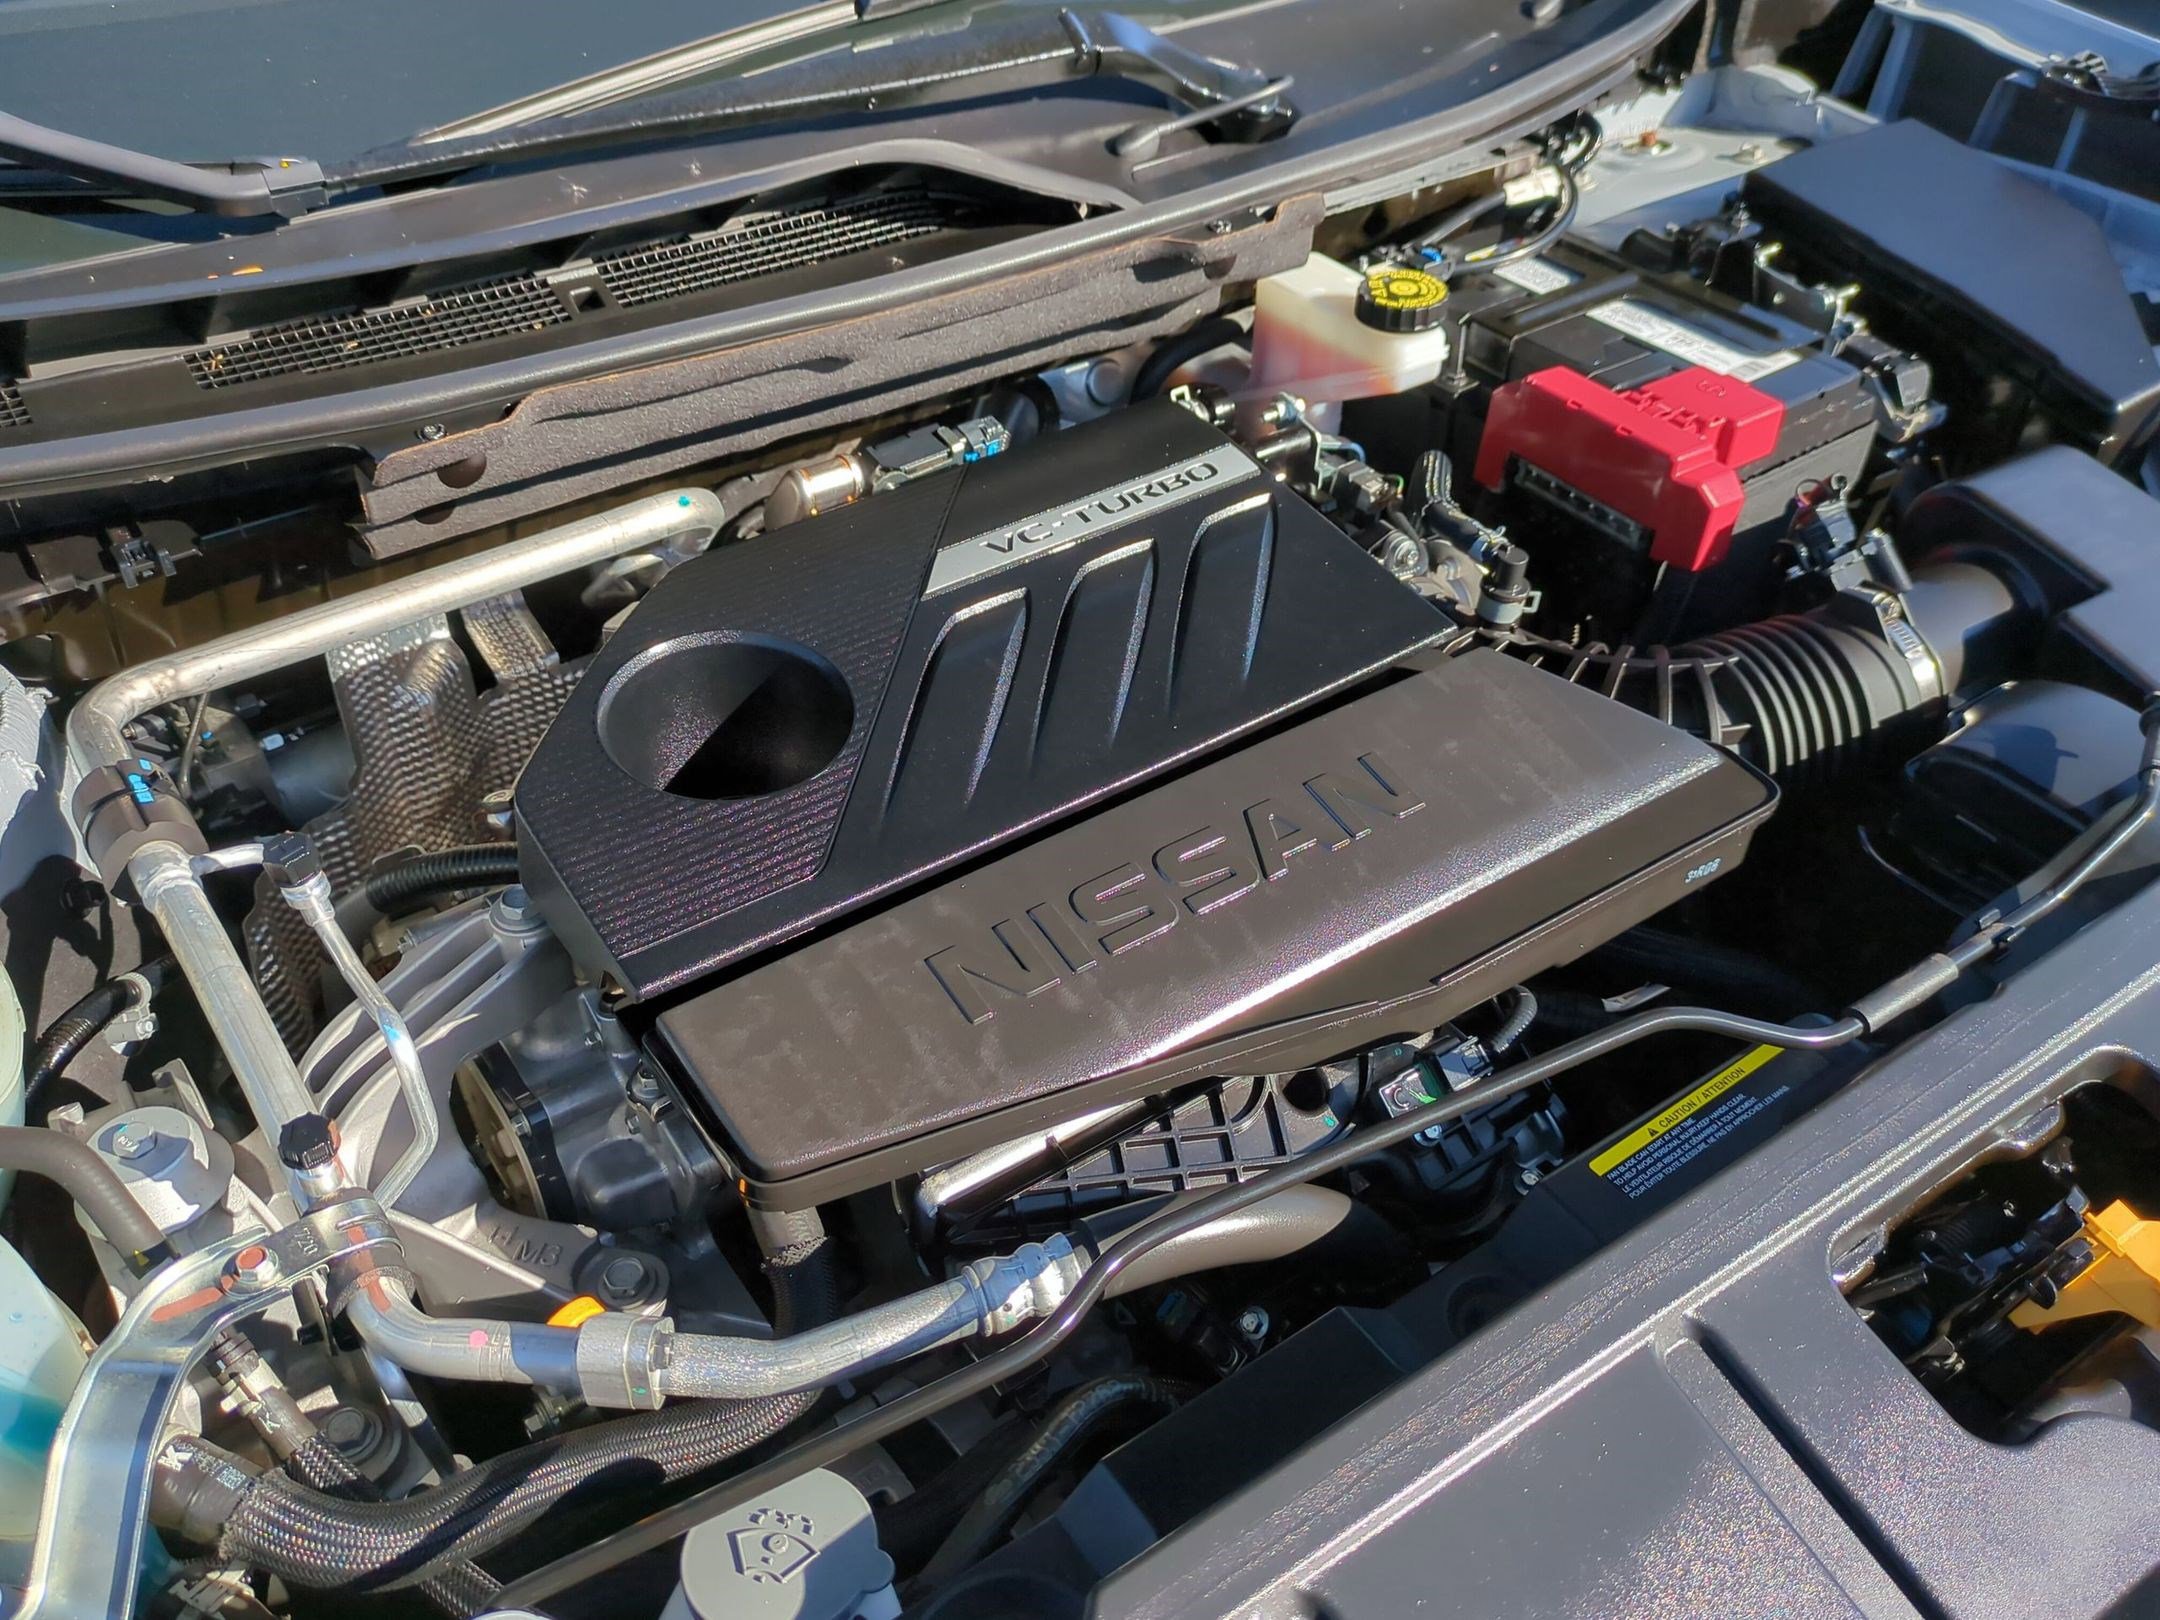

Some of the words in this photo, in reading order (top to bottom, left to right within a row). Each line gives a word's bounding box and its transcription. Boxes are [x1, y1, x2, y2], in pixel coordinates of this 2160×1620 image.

[978, 461, 1219, 554] VC-TURBO
[922, 751, 1427, 1027] NISSAN
[1658, 1099, 1696, 1128] CAUTION
[1701, 1066, 1745, 1098] ATTENTION
[1606, 1169, 1619, 1179] FAN
[1617, 1157, 1637, 1171] BLADE
[1635, 1149, 1648, 1159] CAN
[1646, 1138, 1664, 1151] START
[1670, 1125, 1682, 1135] ANY
[1621, 1167, 1638, 1180] HELP
[1636, 1156, 1654, 1170] AVOID
[1651, 1137, 1682, 1159] PERSONAL
[1708, 1104, 1729, 1120] HANDS
[1628, 1161, 1664, 1187] VENTILATEUR
[1661, 1147, 1684, 1164] RISQUE
[1720, 1111, 1735, 1123] TOUT
[1628, 1184, 1647, 1198] POUR
[1661, 1160, 1681, 1175] TOUTE
[1713, 1128, 1727, 1138] PAS
